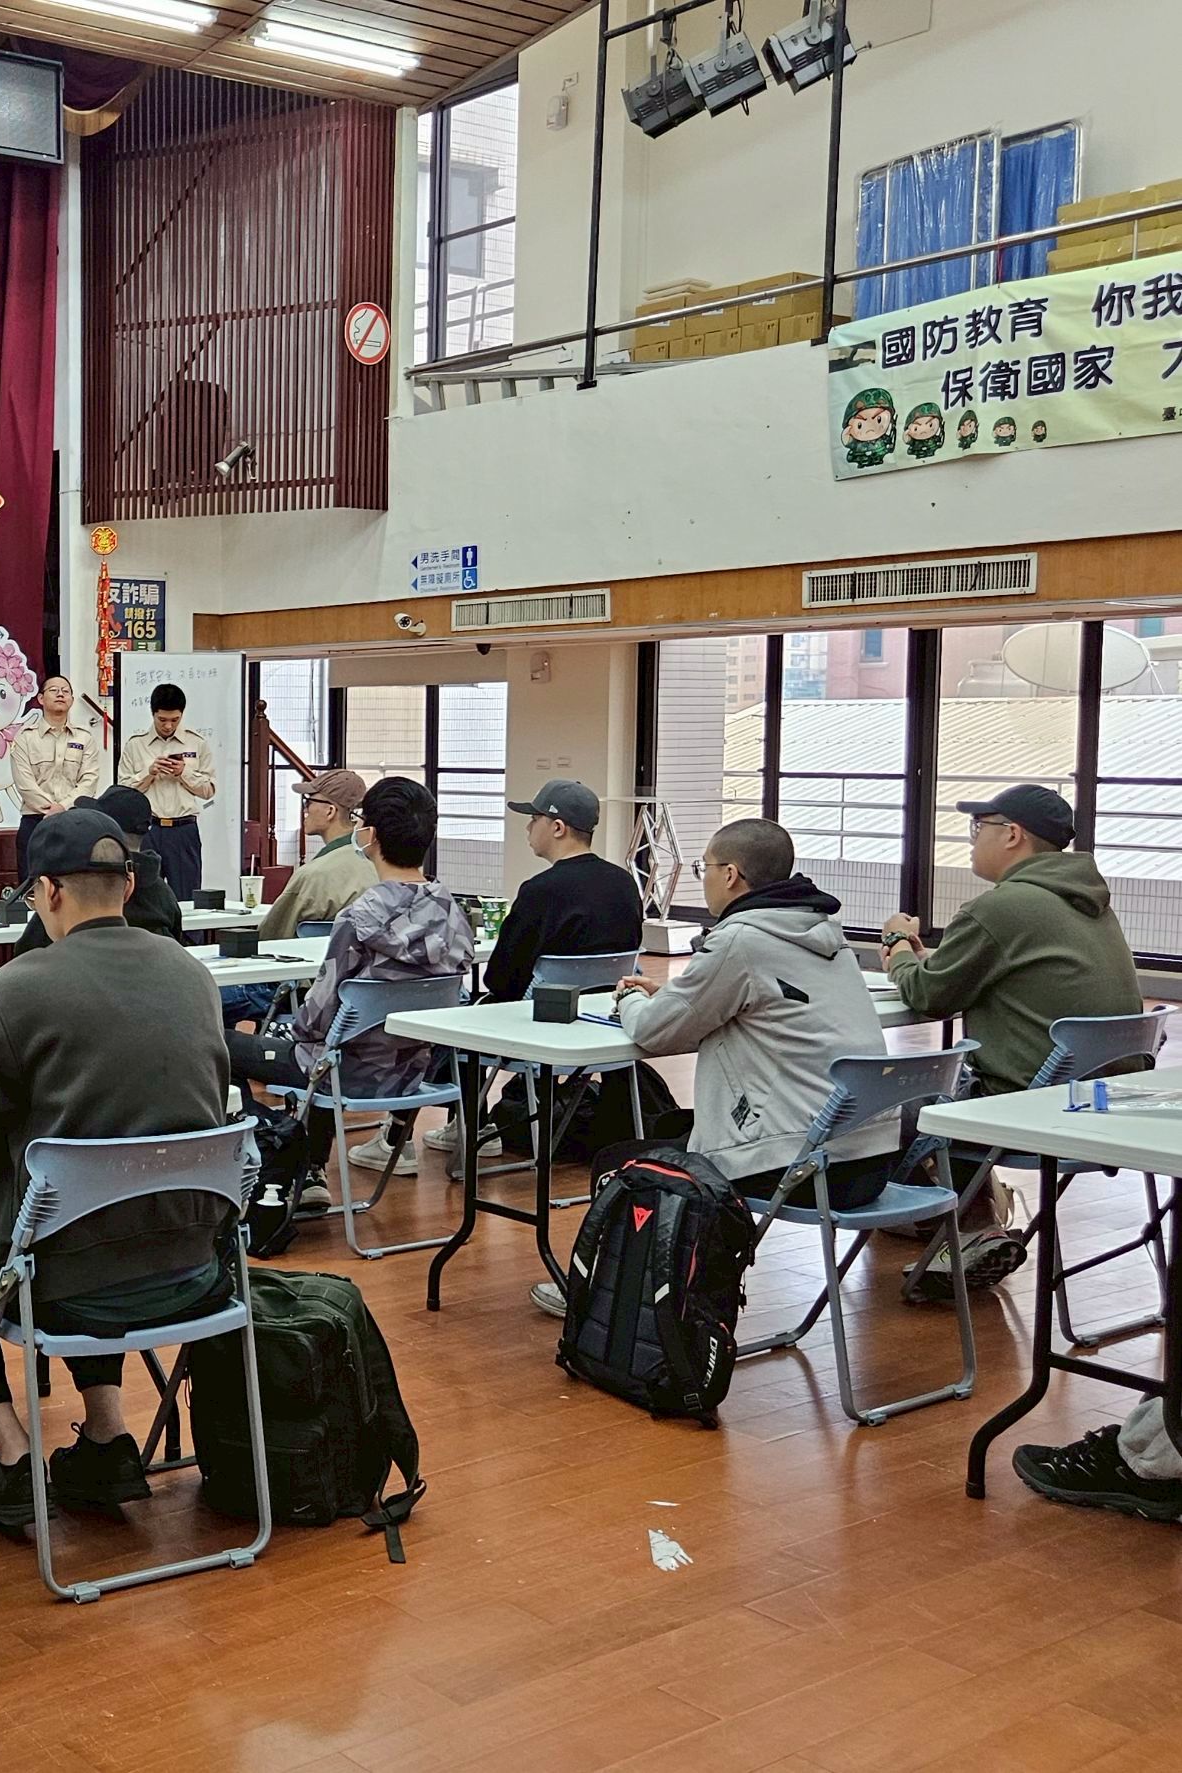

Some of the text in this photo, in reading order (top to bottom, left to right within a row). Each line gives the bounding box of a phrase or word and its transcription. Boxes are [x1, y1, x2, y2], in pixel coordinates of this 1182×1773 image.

[881, 297, 1049, 369] 國防教育
[940, 344, 1115, 411] 保衛國家
[420, 549, 460, 564] 男洗手間
[107, 581, 160, 606] 反詐騙
[124, 620, 157, 639] 165
